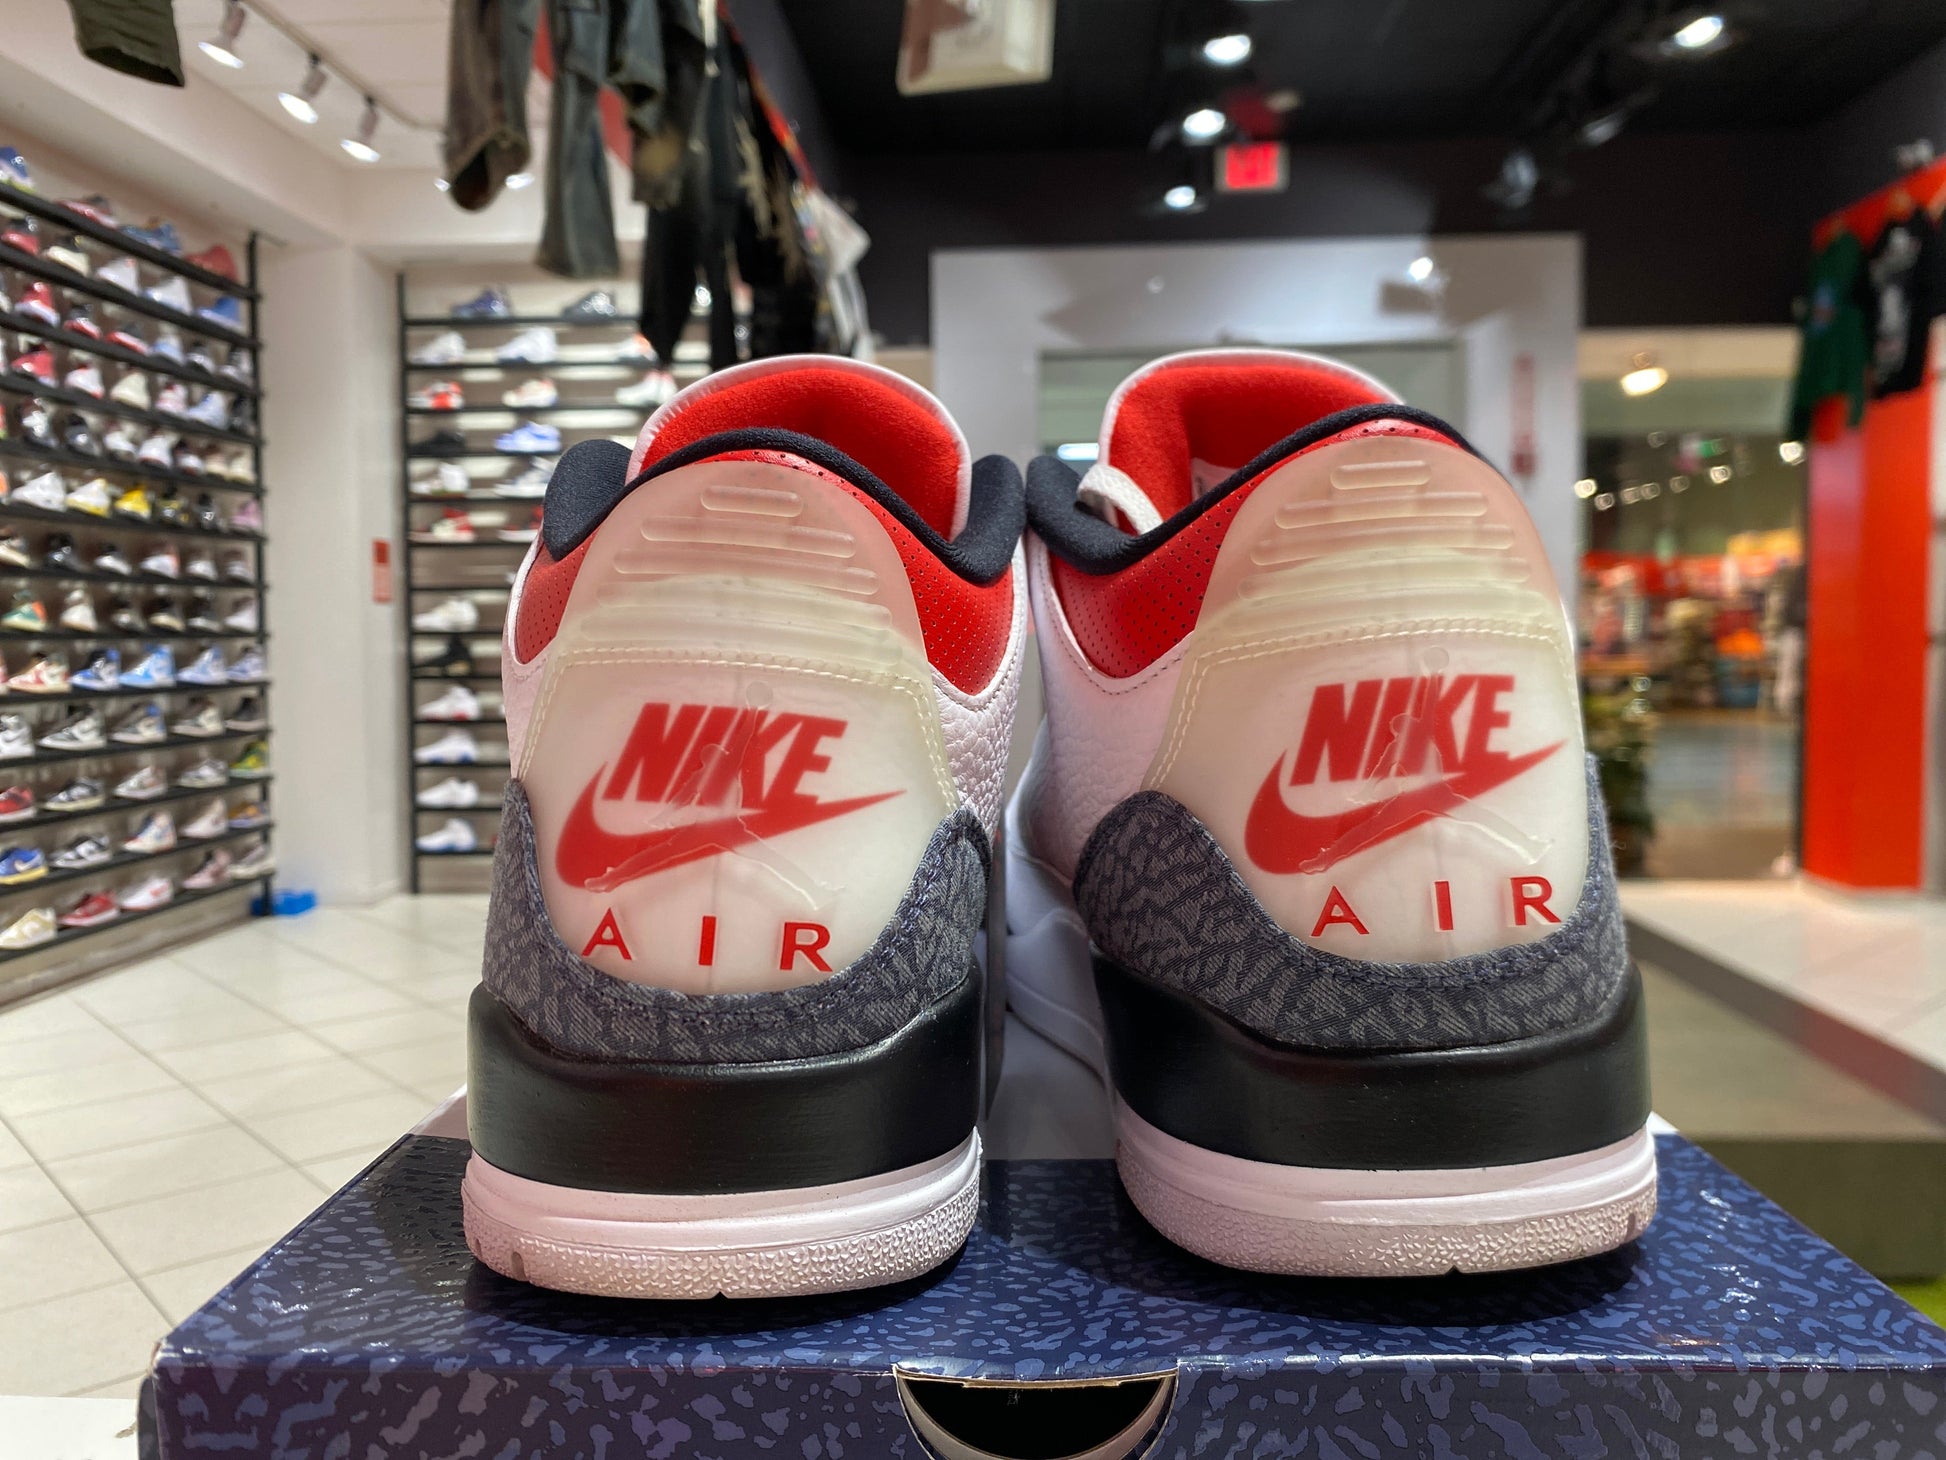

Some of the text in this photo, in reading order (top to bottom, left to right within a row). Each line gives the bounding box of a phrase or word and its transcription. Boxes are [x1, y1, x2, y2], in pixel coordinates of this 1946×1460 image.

[602, 703, 848, 808] NIKE
[1289, 674, 1515, 786] NIKE
[582, 908, 832, 972] AIR
[1311, 875, 1562, 936] AIR
